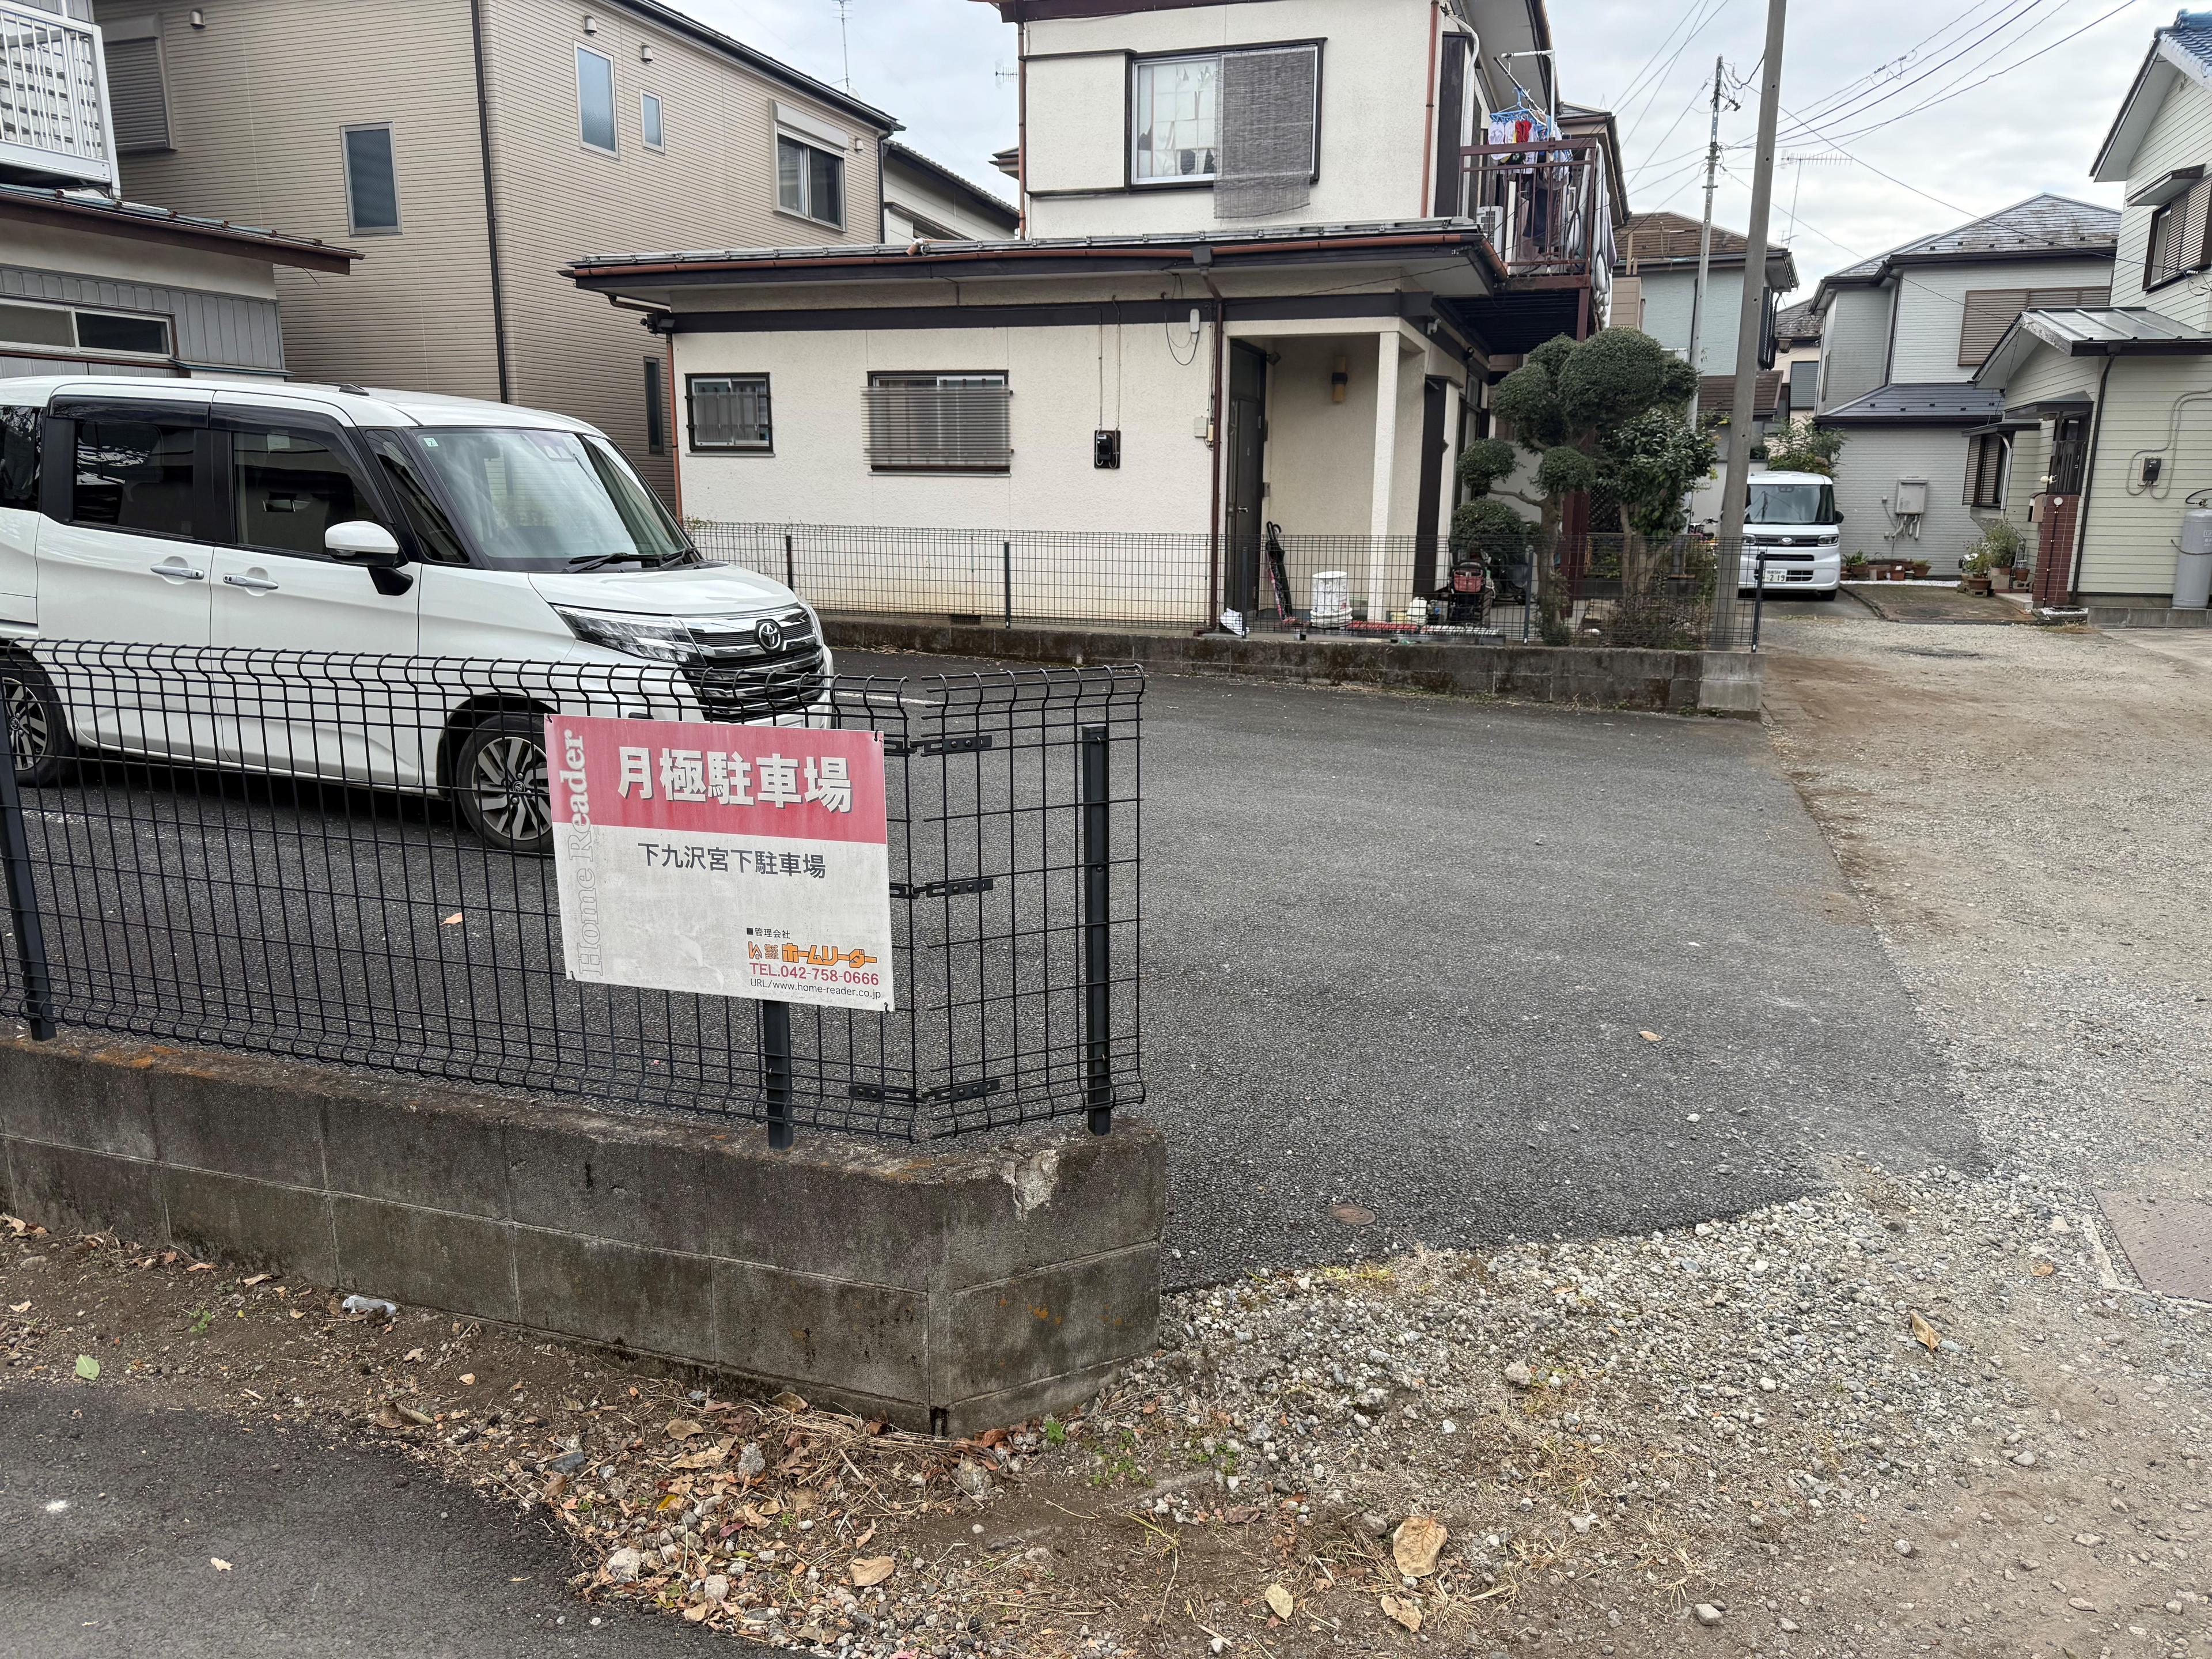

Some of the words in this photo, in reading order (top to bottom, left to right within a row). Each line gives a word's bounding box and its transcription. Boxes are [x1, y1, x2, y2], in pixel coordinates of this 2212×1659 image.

[559, 728, 594, 862] Reader
[618, 746, 853, 814] 月極駐車場
[638, 842, 827, 879] 下九沢宮下駐車場
[577, 868, 603, 977] Home
[782, 942, 877, 968] ホームリーダー
[749, 962, 880, 986] TEL.042-758-0666
[750, 978, 881, 999] URL/www.home-reader.co.jp
